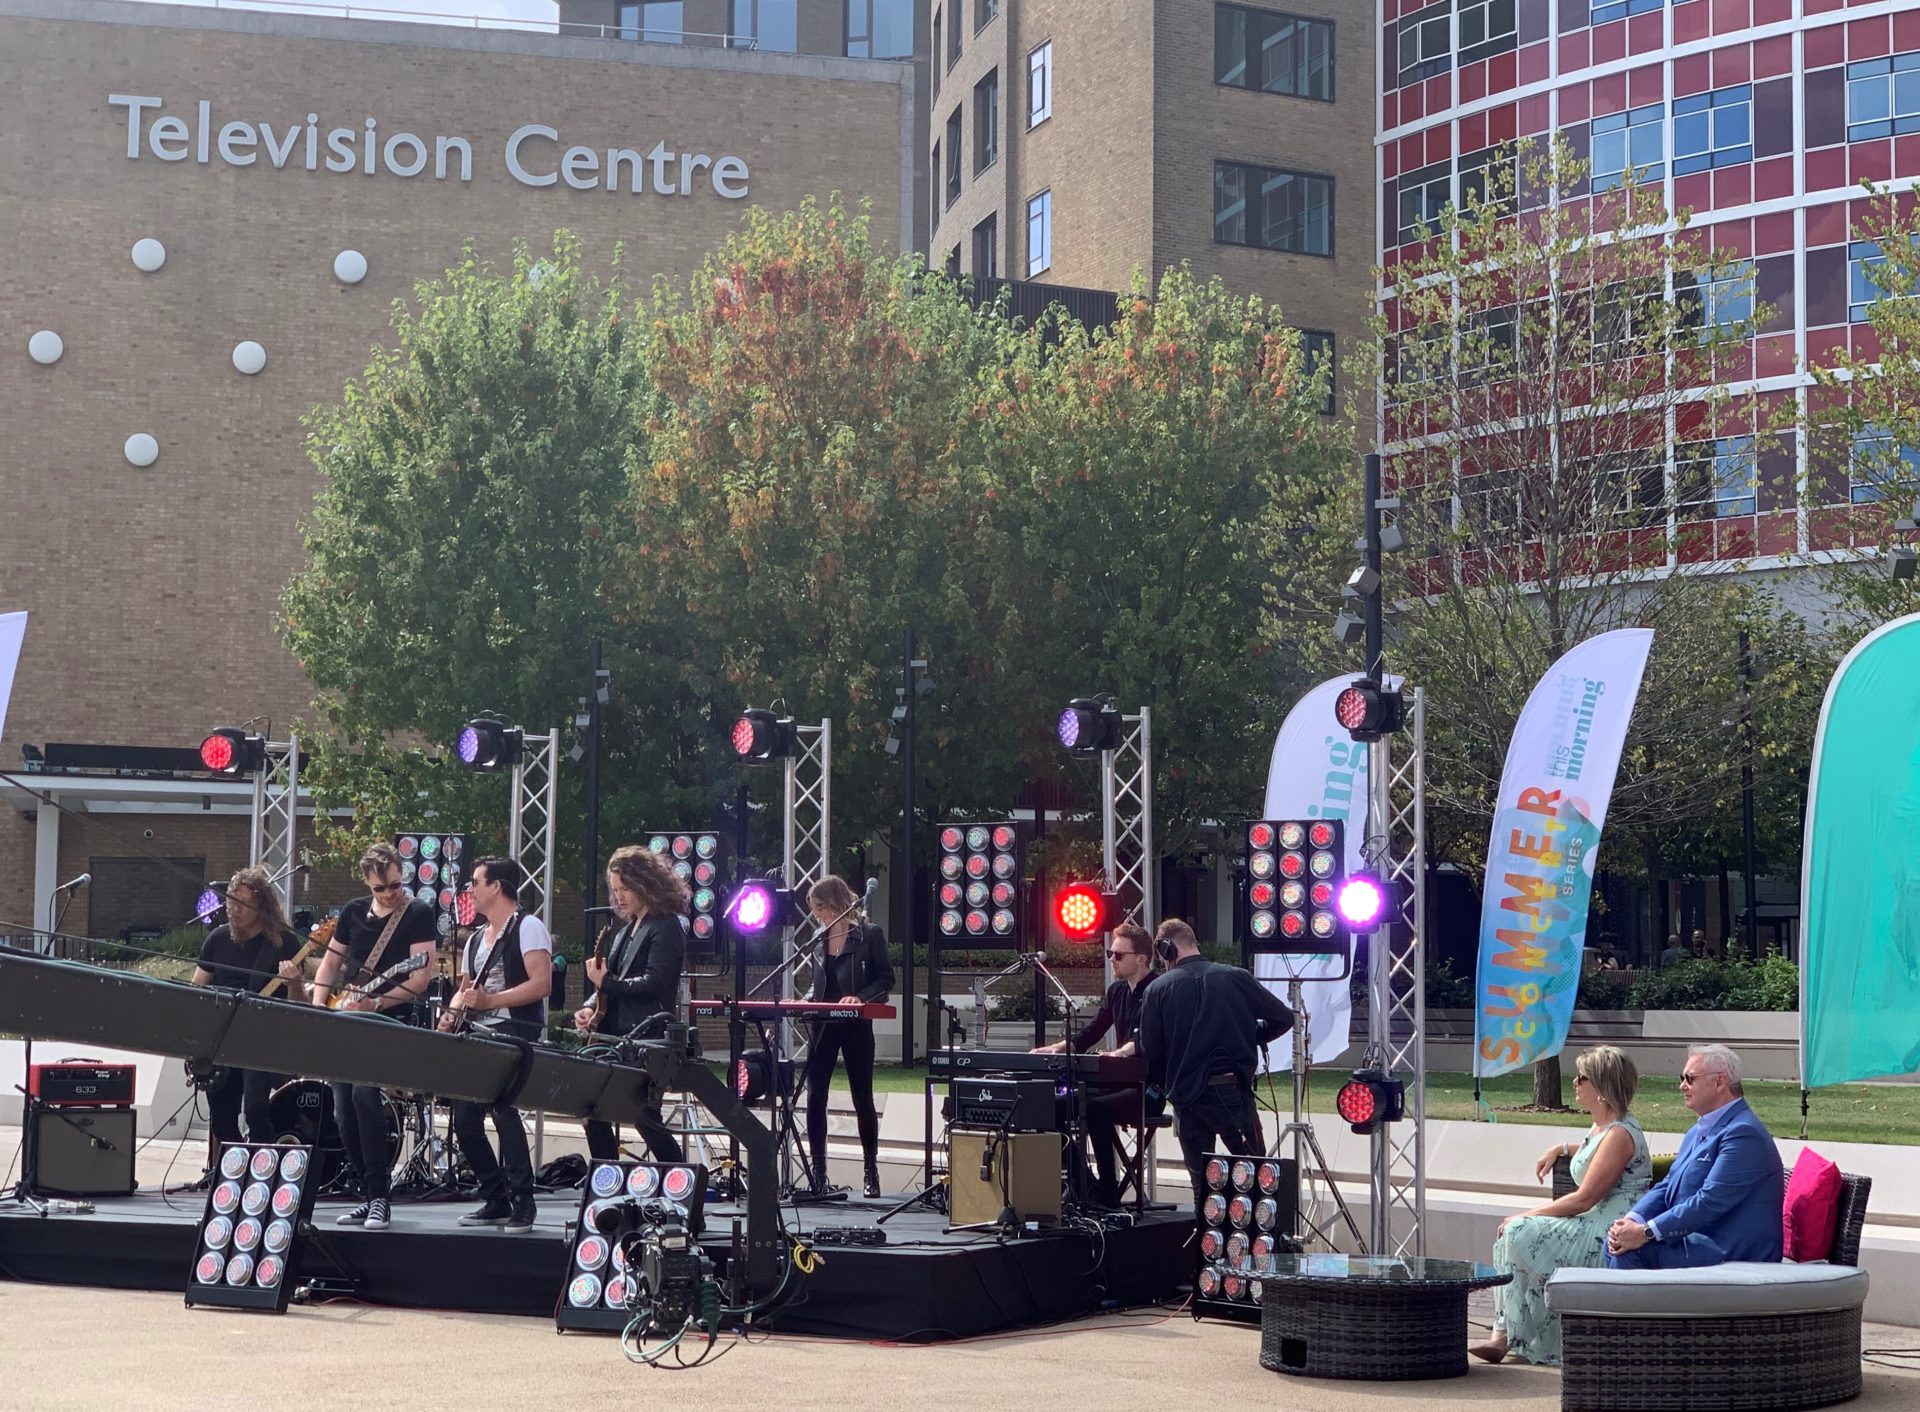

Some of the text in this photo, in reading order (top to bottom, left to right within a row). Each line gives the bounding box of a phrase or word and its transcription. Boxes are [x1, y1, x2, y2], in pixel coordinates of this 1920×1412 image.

[108, 93, 750, 199] Television Centre
[1565, 677, 1606, 781] morning
[1549, 745, 1570, 777] this
[1563, 837, 1583, 896] SERIES
[1480, 787, 1561, 1064] SUMMER
[696, 1007, 713, 1015] nord
[829, 1009, 854, 1018] electro
[75, 1085, 97, 1094] 633
